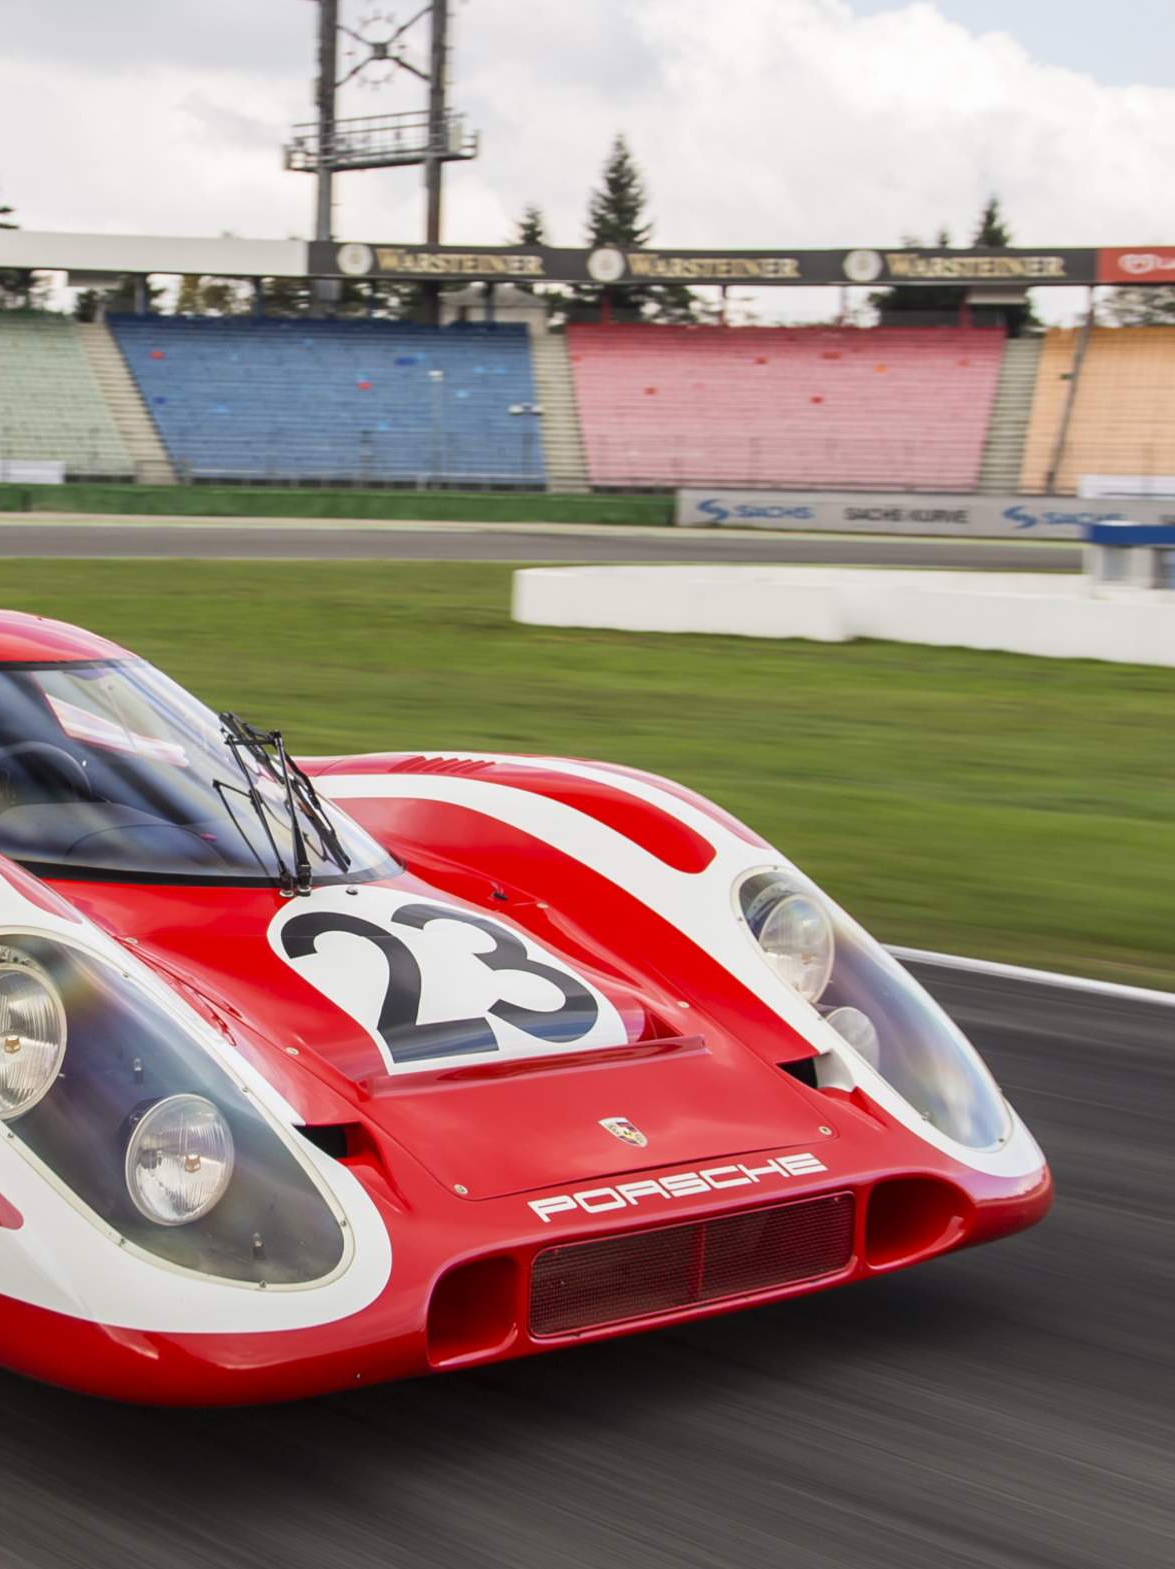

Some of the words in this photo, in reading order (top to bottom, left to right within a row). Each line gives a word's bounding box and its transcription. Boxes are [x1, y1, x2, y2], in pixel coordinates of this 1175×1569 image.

[376, 248, 546, 274] WARSTEINER
[627, 253, 801, 278] WARSTEINER
[885, 253, 1067, 277] WARSTEINER
[733, 504, 815, 520] SACHS
[280, 903, 599, 1064] 23
[527, 1152, 828, 1223] PORSCHE
